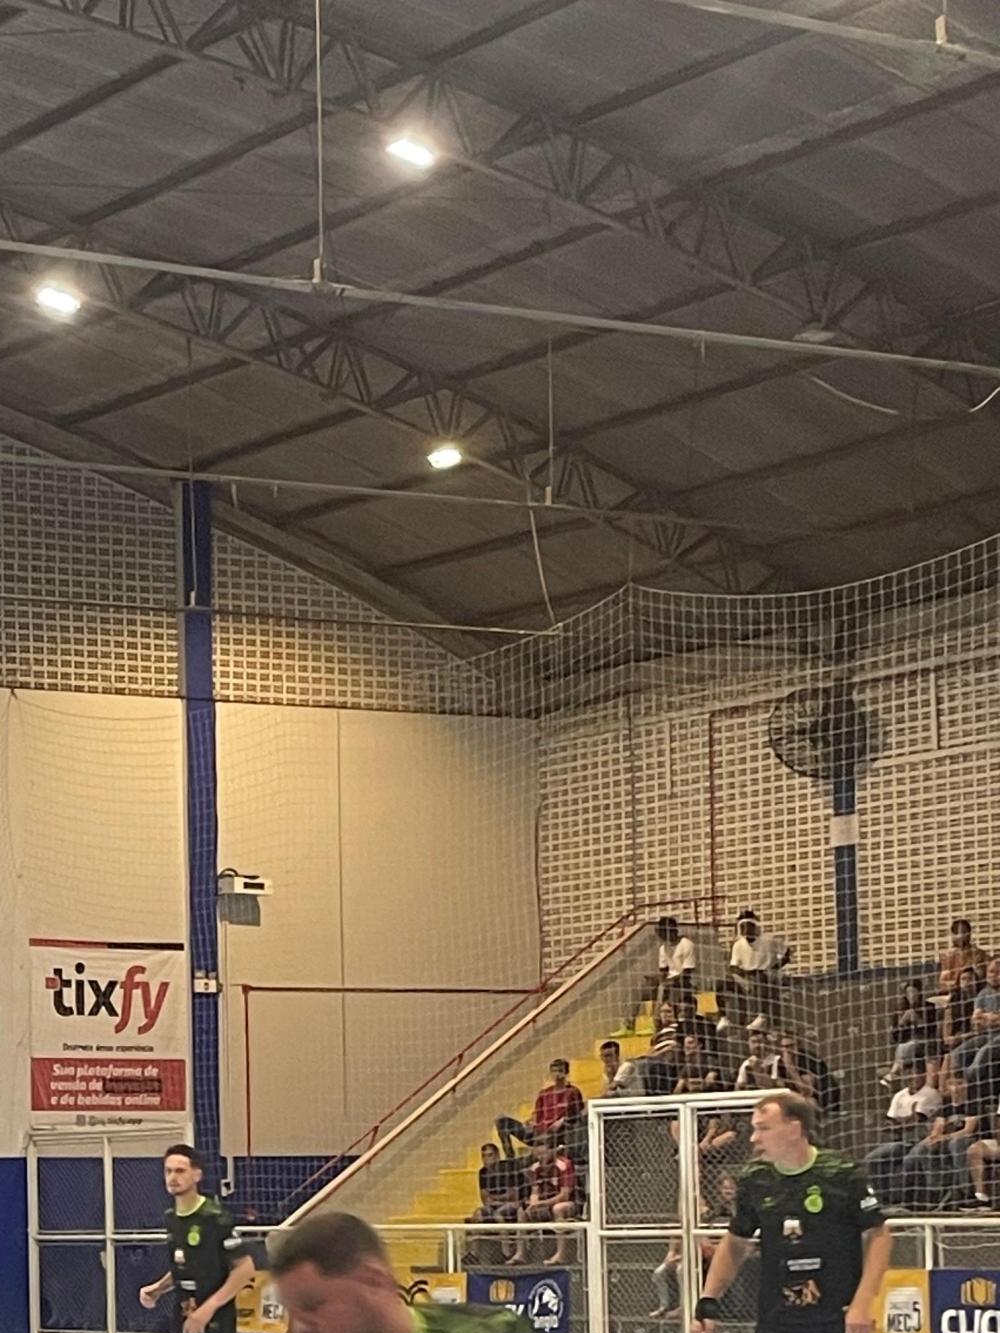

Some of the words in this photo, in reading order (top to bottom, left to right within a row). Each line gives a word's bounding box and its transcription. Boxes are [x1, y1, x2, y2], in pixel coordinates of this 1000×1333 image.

[45, 962, 171, 1035] tixfy
[52, 1064, 75, 1077] Sua
[76, 1064, 142, 1079] plataforma
[144, 1065, 159, 1077] de
[60, 1093, 75, 1106] de
[77, 1093, 123, 1106] bebidas
